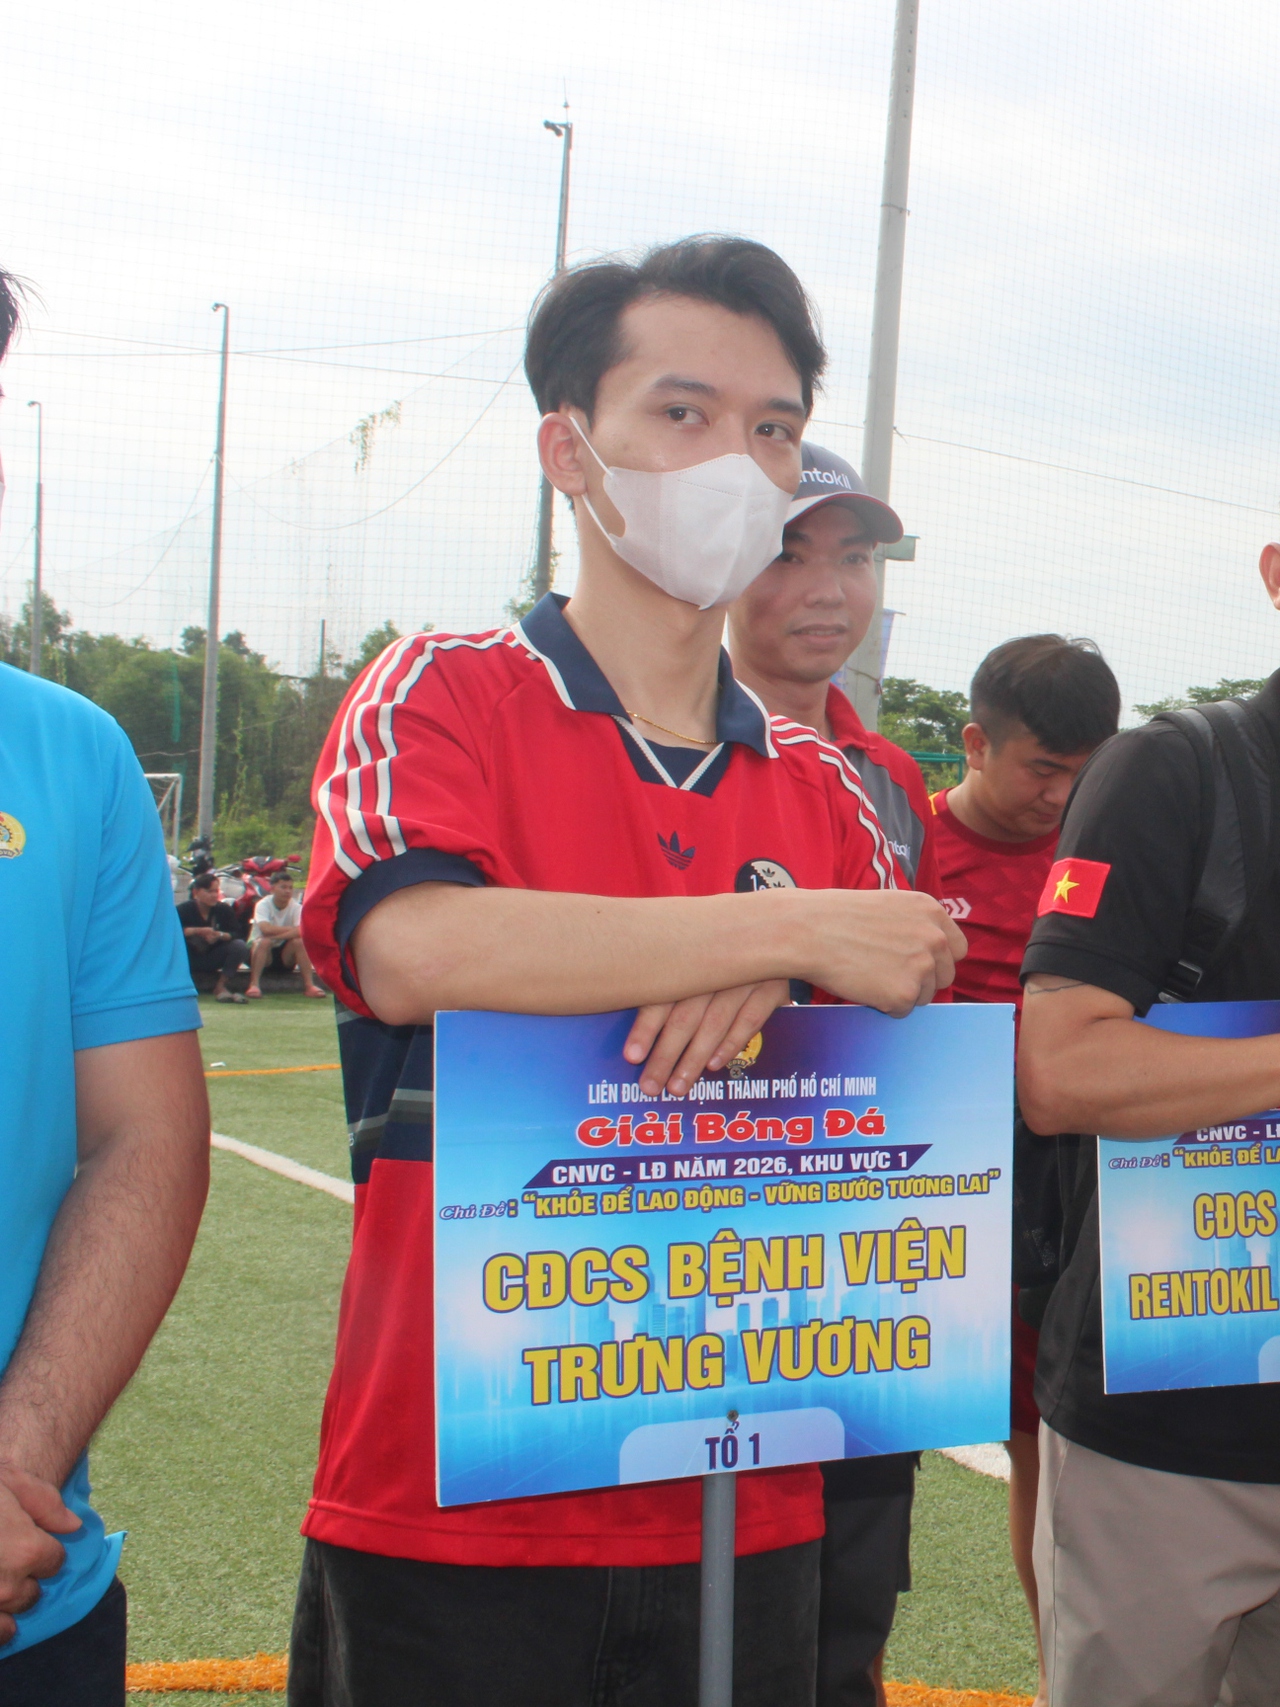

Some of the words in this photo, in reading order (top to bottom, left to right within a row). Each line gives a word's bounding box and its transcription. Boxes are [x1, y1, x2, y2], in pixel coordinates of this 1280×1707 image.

[800, 467, 852, 490] ntokil
[588, 1080, 617, 1104] LIÊN
[622, 1083, 658, 1103] ĐO
[689, 1077, 723, 1105] ĐỘNG
[727, 1073, 768, 1099] THÀNH
[772, 1072, 797, 1098] PHỐ
[800, 1072, 816, 1098] HỒ
[820, 1074, 841, 1097] CHÍ
[844, 1077, 877, 1096] MINH
[576, 1111, 684, 1148] Giải
[693, 1111, 814, 1145] Bóng
[823, 1107, 886, 1138] Đá
[1196, 1124, 1247, 1142] CNVC
[552, 1163, 615, 1184] CNVC
[639, 1161, 667, 1180] LĐ
[674, 1156, 727, 1178] NĂM
[733, 1157, 793, 1176] 2026,
[800, 1154, 843, 1173] KHU
[850, 1151, 891, 1173] VỰC
[898, 1151, 907, 1168] 1
[1108, 1156, 1137, 1169] Chủ
[1236, 1141, 1262, 1166] ĐỂ
[439, 1204, 477, 1220] Chủ
[601, 1183, 635, 1215] ĐỂ
[636, 1189, 679, 1212] LAO
[684, 1183, 745, 1213] ĐỘNG
[764, 1179, 822, 1205] VỮNG
[826, 1175, 883, 1201] BƯỚC
[887, 1174, 955, 1199] TƯƠNG
[1194, 1189, 1277, 1240] CĐCS
[483, 1244, 649, 1314] CĐCS
[668, 1227, 824, 1307] BỆNH
[839, 1217, 967, 1294] VIỆN
[1129, 1263, 1279, 1320] RENTOKIL
[522, 1332, 725, 1405] TRƯNG
[741, 1315, 931, 1386] VƯƠNG
[705, 1421, 740, 1470] TỔ
[748, 1432, 760, 1465] 1
